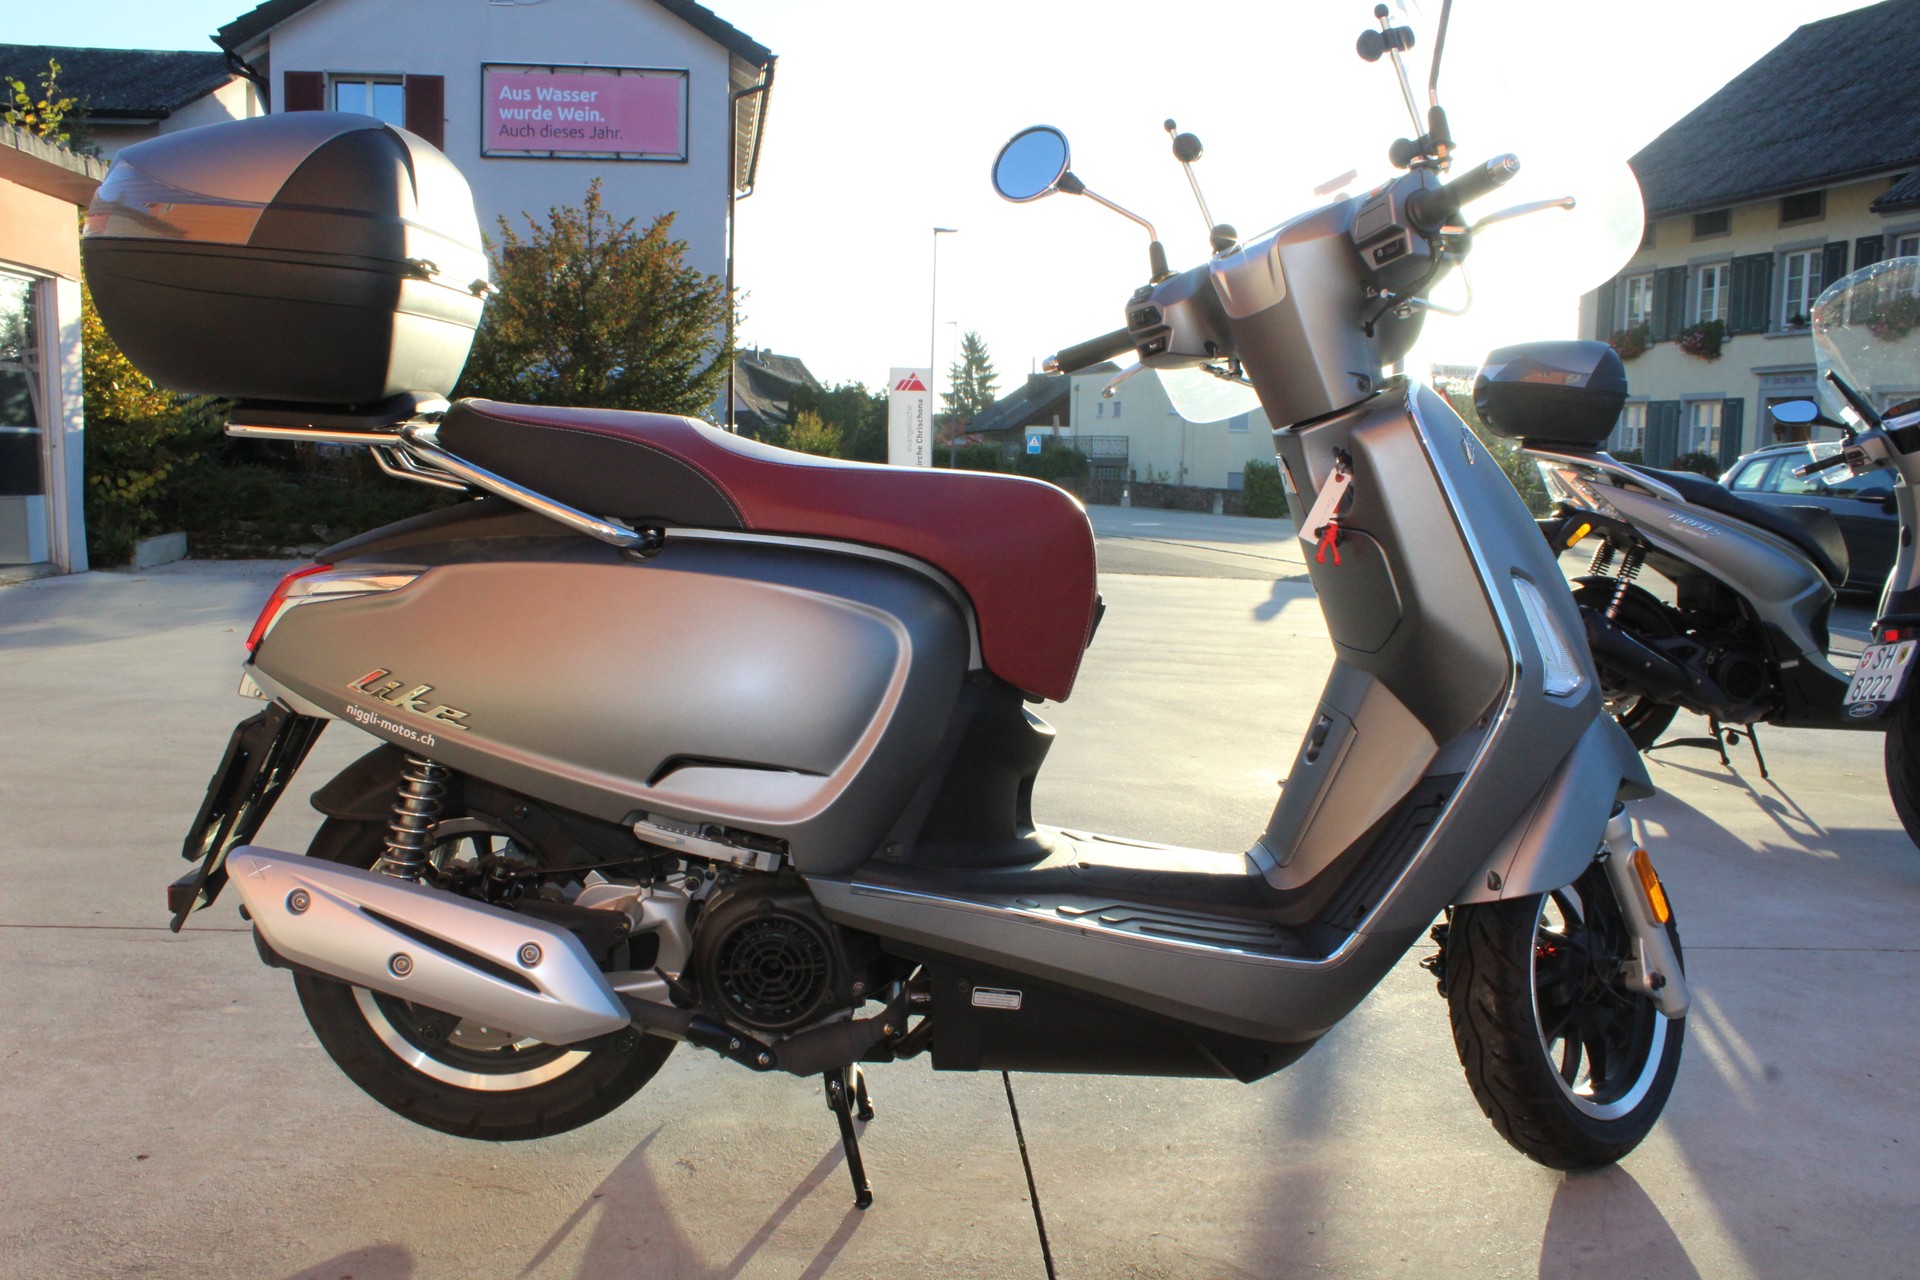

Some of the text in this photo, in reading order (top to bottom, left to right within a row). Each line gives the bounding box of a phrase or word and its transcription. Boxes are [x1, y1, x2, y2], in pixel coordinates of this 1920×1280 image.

[499, 86, 598, 103] Aus Wasser
[499, 105, 605, 122] wurde Wein.
[499, 124, 623, 140] Auch dieses Jahr.
[915, 399, 924, 467] irche Chrischona
[1873, 645, 1899, 669] SH
[1852, 676, 1892, 701] 8222
[347, 704, 435, 746] niggli-motos.ch
